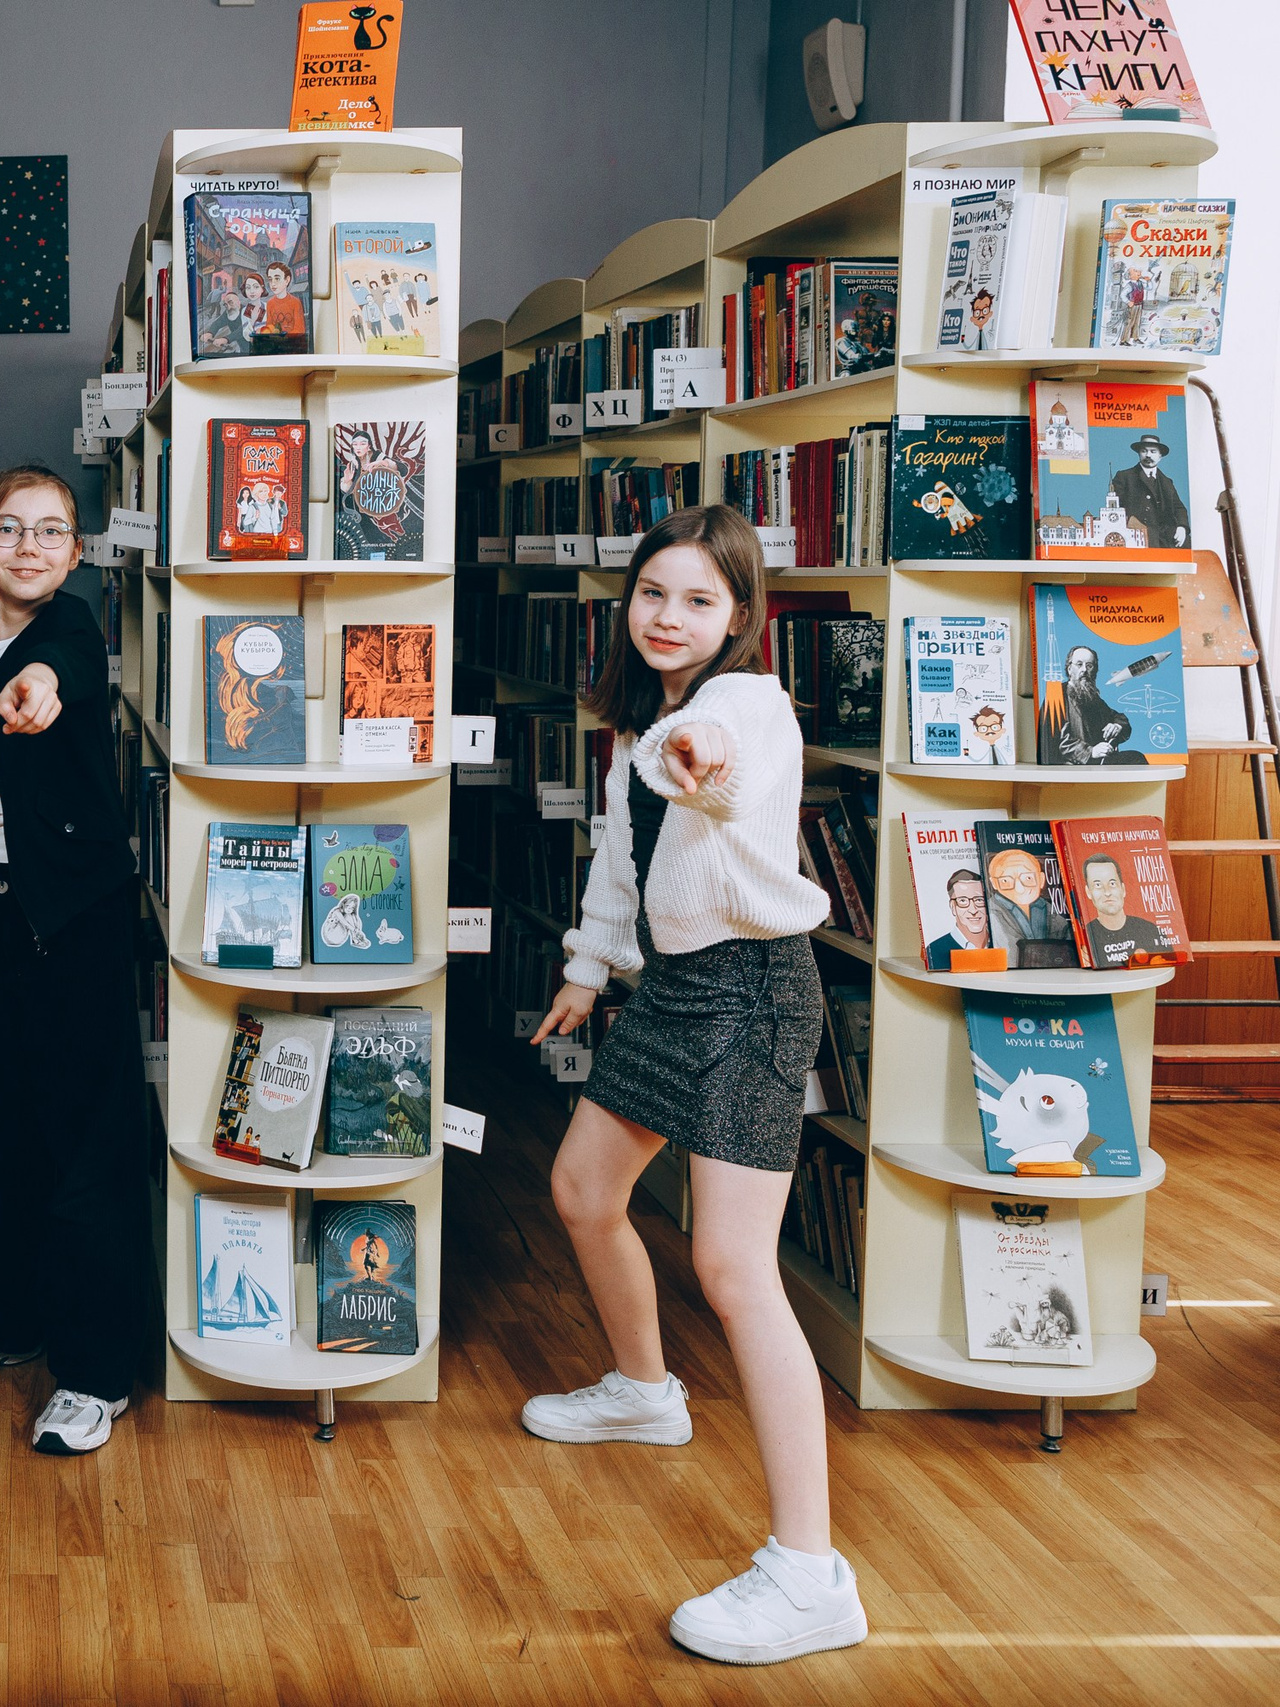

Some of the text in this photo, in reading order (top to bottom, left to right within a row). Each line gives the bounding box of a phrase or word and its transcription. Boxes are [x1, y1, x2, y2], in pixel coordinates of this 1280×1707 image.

[1034, 30, 1168, 56] ПАХНУТ
[303, 52, 364, 60] Приключения
[301, 59, 371, 75] кота-
[300, 74, 377, 89] детектива
[1048, 63, 1185, 91] КНИГИ
[338, 98, 372, 111] Дело
[298, 120, 375, 131] невидимке
[190, 180, 280, 192] ЧИТАТЬ КРУТО!
[913, 178, 1017, 191] Я ПОЗНАЮ МИР
[208, 204, 301, 222] Страница
[1163, 205, 1226, 213] НАУЧНЫЕ СКАЗКИ
[229, 225, 281, 235] один
[1130, 219, 1208, 243] Сказки
[344, 236, 404, 254] ВТОРОЙ
[1122, 243, 1212, 258] о химии
[951, 246, 968, 259] Что
[944, 313, 961, 328] Кто
[661, 354, 687, 363] 84. (3)
[104, 382, 143, 390] Бондарев
[681, 380, 699, 397] А
[1092, 391, 1114, 401] ЧТО
[612, 398, 629, 418] Ц
[1093, 401, 1150, 412] ПРИДУМАЛ
[98, 414, 111, 429] А
[556, 413, 572, 428] Ф
[933, 419, 991, 428] ЖЗЛ для детей
[1094, 412, 1133, 422] ЩУСЕВ
[495, 429, 507, 443] С
[935, 429, 1006, 445] Кто такой
[243, 445, 283, 458] ГОМЕР
[901, 441, 988, 474] Гагарин?
[246, 459, 280, 473] ПИМ
[359, 471, 399, 491] СОЛНЦЕ
[113, 516, 150, 530] Булгаков
[562, 543, 576, 557] Ч
[1088, 595, 1109, 604] ЧТО
[1089, 605, 1144, 614] ПРИДУМАЛ
[1089, 614, 1166, 624] ЦИОЛКОВСКИЙ
[917, 630, 937, 641] НА
[920, 664, 952, 673] Какие
[469, 729, 484, 747] Г
[927, 726, 957, 739] Как
[916, 830, 958, 844] БИЛЛ
[996, 833, 1042, 844] ЧЕМУ МОГУ
[1081, 829, 1161, 844] ЧЕМУ МОГУ НАУЧИТЬСЯ
[225, 839, 290, 858] Тайны
[220, 859, 246, 867] морей
[260, 861, 298, 869] островов
[1134, 855, 1169, 882] ИЛОНА
[337, 855, 384, 892] ЭЛЛА
[370, 894, 404, 911] СТОРОНКЕ
[1141, 884, 1176, 912] МАСКА
[473, 917, 487, 926] М.
[1156, 925, 1174, 936] Tesla
[1104, 940, 1135, 954] OCCUPY
[1107, 952, 1129, 962] MARS
[344, 1020, 418, 1033] ПОСЛЕДНИЙ
[1002, 1016, 1084, 1036] БОЯКА
[346, 1035, 417, 1059] ЭЛЬФ
[1005, 1038, 1085, 1050] МУХИ НЕ ОБИДИТ
[563, 1056, 578, 1071] Я
[460, 1126, 481, 1138] А.С.
[222, 1239, 263, 1255] ПЛАВАТЬ
[1141, 1288, 1160, 1304] И
[340, 1294, 396, 1322] ЛАБРИС
